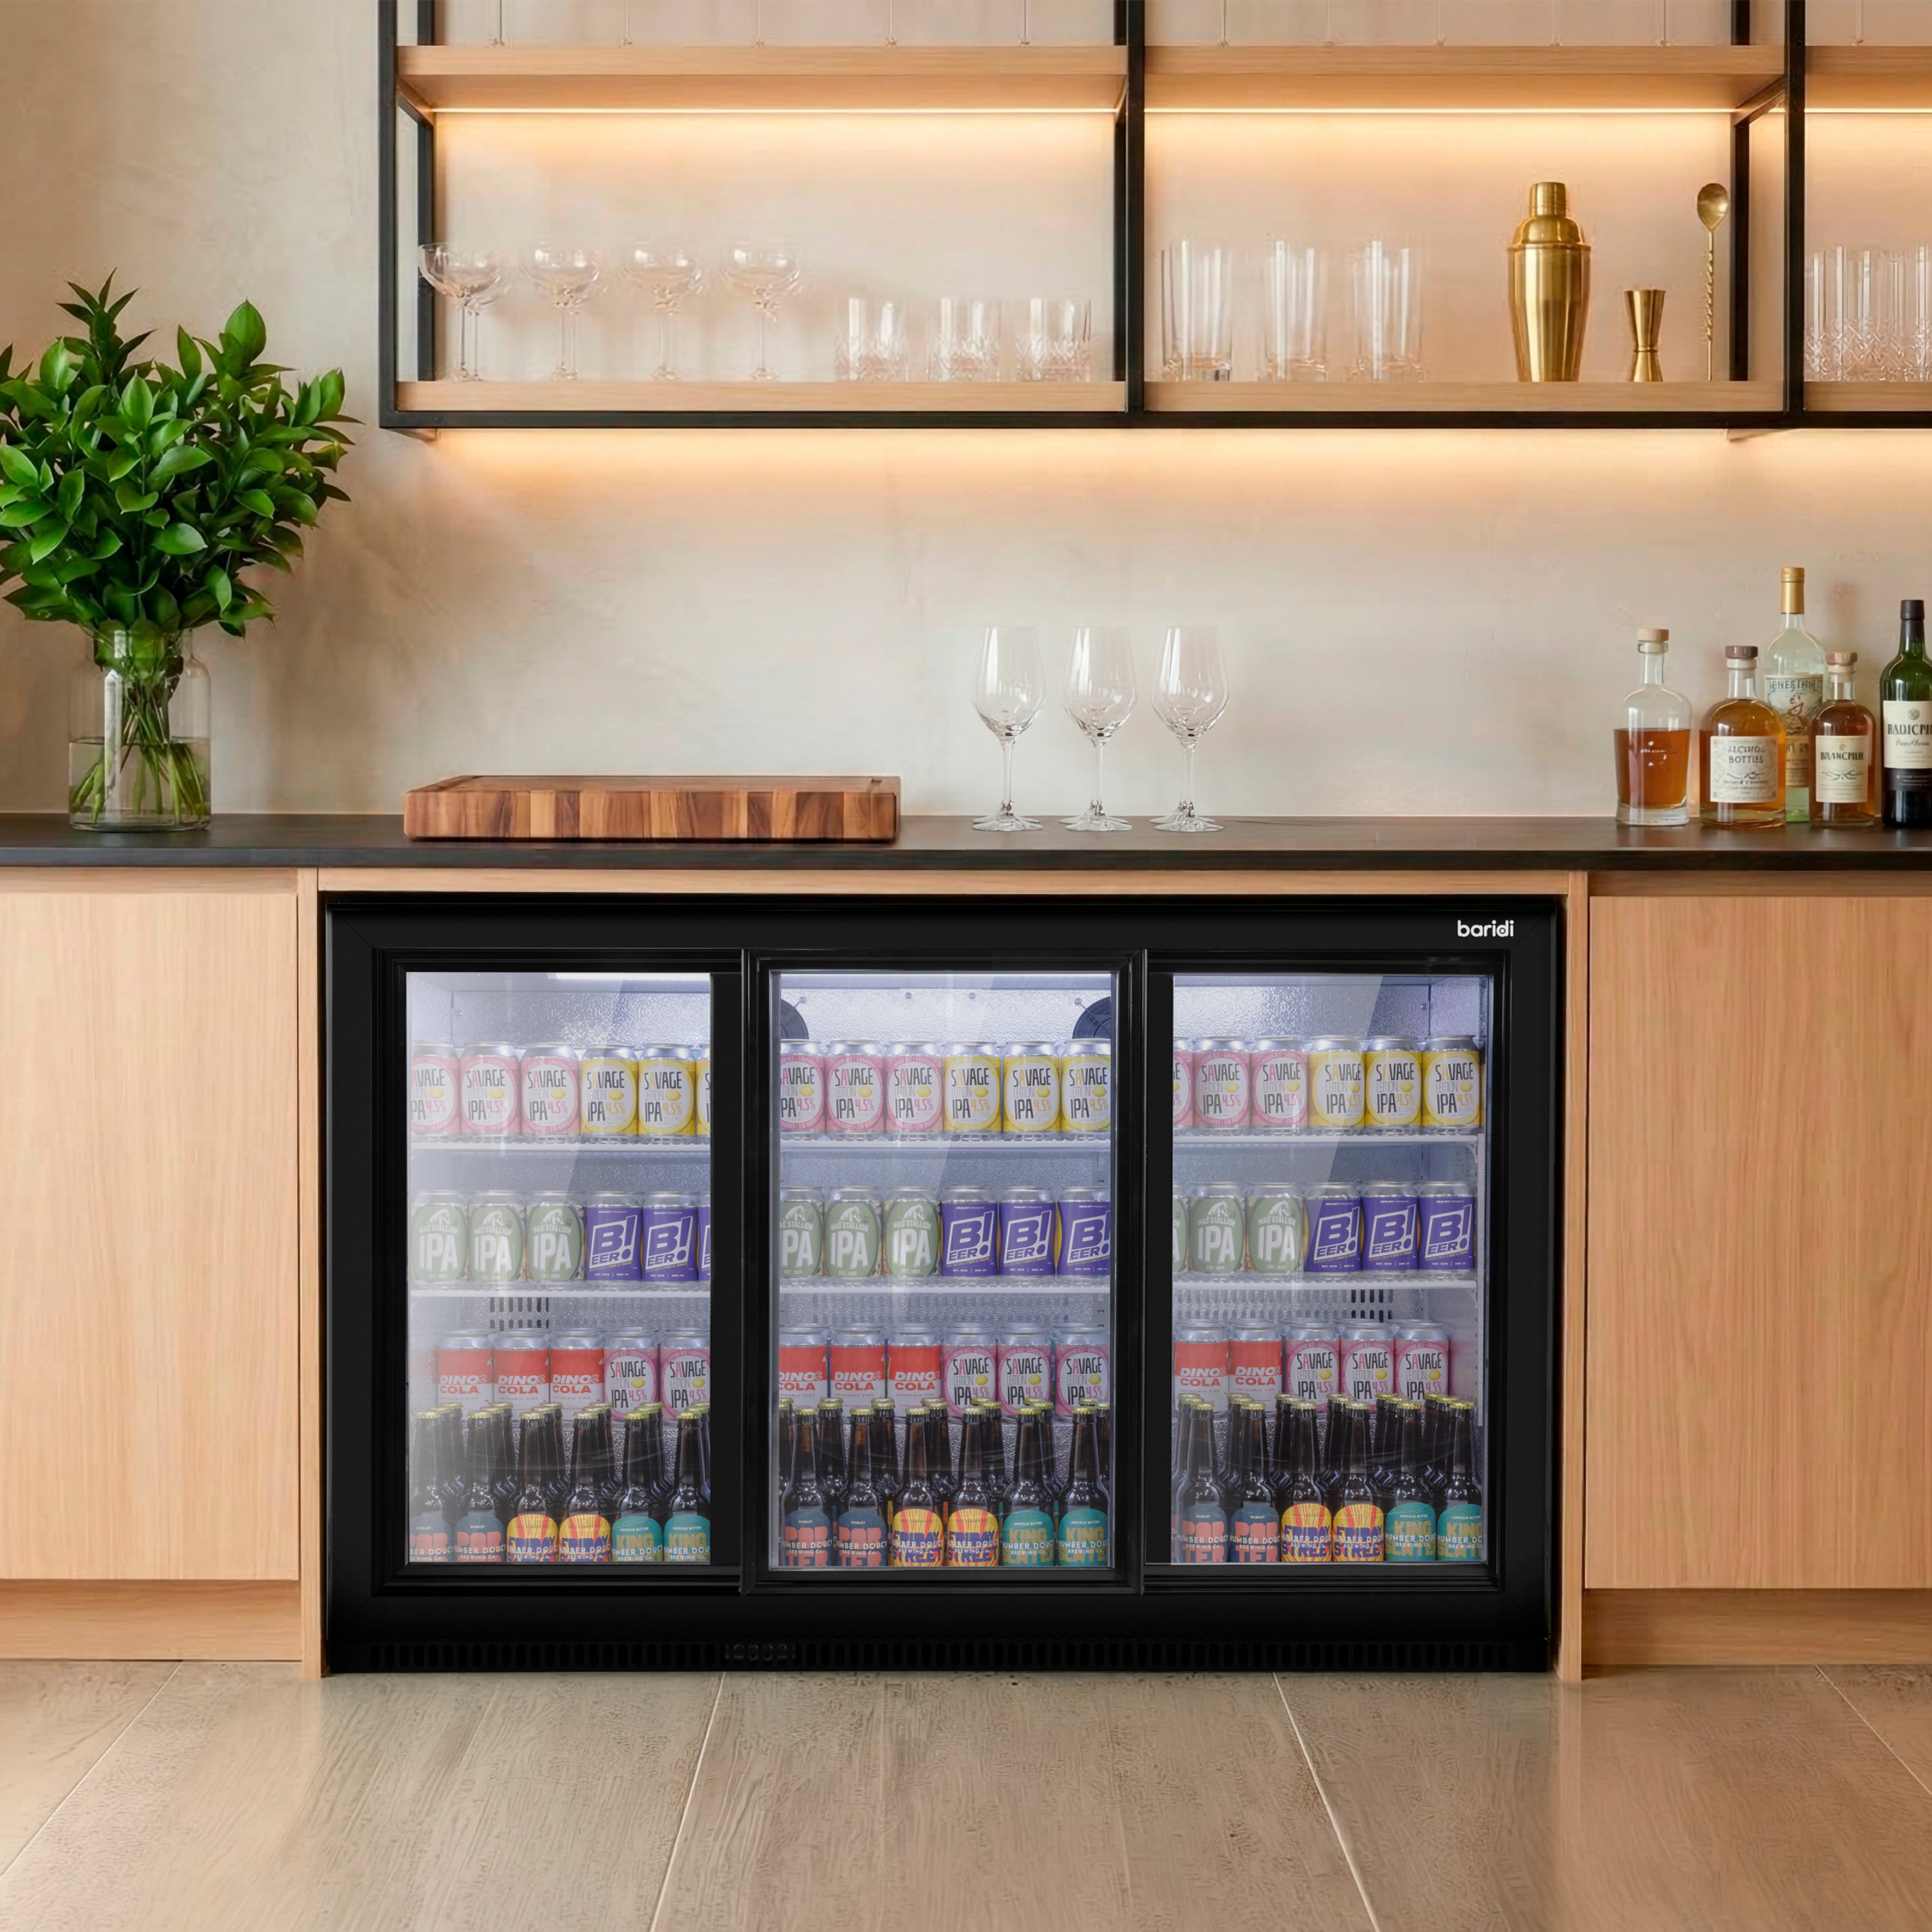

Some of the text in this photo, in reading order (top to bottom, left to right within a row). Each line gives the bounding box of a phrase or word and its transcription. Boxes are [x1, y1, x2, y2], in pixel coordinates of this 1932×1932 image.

[1729, 755, 1764, 763] BOTTLES
[1457, 920, 1514, 937] baridi
[467, 1069, 505, 1088] SAVAGE
[528, 1069, 567, 1089] SAVAGE
[587, 1071, 624, 1090] SAVAGE
[645, 1071, 682, 1090] SAVAGE
[835, 1067, 873, 1086] SAVAGE
[894, 1067, 932, 1086] SAVAGE
[951, 1068, 989, 1087] SAVAGE
[1013, 1067, 1051, 1087] SAVAGE
[1070, 1067, 1108, 1086] SAVAGE
[1202, 1063, 1239, 1082] SAVAGE
[1263, 1063, 1301, 1082] SAVAGE
[1326, 1063, 1361, 1082] SAVAGE
[1376, 1063, 1414, 1081] SAVAGE
[1435, 1063, 1473, 1081] SAVAGE
[587, 1090, 606, 1100] LEMON
[645, 1090, 664, 1101] LEMON
[952, 1086, 972, 1098] LEMON
[1070, 1086, 1091, 1097] LEMON
[1376, 1082, 1398, 1092] LEMON
[468, 1100, 507, 1121] IPA 4.5%
[529, 1100, 548, 1121] IPA
[588, 1102, 625, 1122] IPA 4.5%
[645, 1102, 683, 1122] IPA 4.5%
[836, 1098, 874, 1119] IPA 4.5%
[895, 1098, 933, 1118] IPA 4.5%
[952, 1098, 990, 1119] IPA 4.5%
[1014, 1099, 1052, 1120] IPA 4.5%
[1070, 1098, 1109, 1119] IPA 4.5%
[1203, 1094, 1241, 1114] IPA 4.5%
[1265, 1093, 1302, 1114] IPA 4.5%
[1326, 1093, 1346, 1114] IPA
[1377, 1093, 1415, 1114] IPA 4.5%
[1437, 1093, 1474, 1114] IPA 4.5%
[545, 1225, 572, 1235] STALLION
[830, 1222, 869, 1232] MAD STALLION
[905, 1220, 931, 1230] STALLION
[1209, 1217, 1236, 1227] STALLION
[1270, 1217, 1296, 1226] STALLION
[473, 1226, 512, 1236] MAD STALLION
[419, 1233, 458, 1272] IPA
[533, 1233, 571, 1272] IPA
[830, 1230, 868, 1269] IPA
[893, 1229, 931, 1267] IPA
[1198, 1225, 1235, 1263] IPA
[1257, 1225, 1295, 1263] IPA
[474, 1235, 512, 1273] IPA
[610, 1361, 646, 1378] SAVAGE
[670, 1360, 706, 1378] SAVAGE
[953, 1357, 989, 1375] SAVAGE
[1006, 1357, 1042, 1374] SAVAGE
[1067, 1356, 1102, 1375] SAVAGE
[1297, 1352, 1332, 1369] SAVAGE
[1353, 1352, 1388, 1369] SAVAGE
[1406, 1352, 1441, 1370] SAVAGE
[440, 1375, 479, 1384] DINO
[498, 1375, 538, 1384] DINO
[552, 1374, 591, 1384] DINO
[834, 1371, 873, 1381] DINO
[894, 1371, 934, 1381] DINO
[1181, 1368, 1219, 1376] DINO
[1235, 1367, 1274, 1376] DINO
[1297, 1369, 1317, 1380] LEMON
[1353, 1370, 1373, 1380] LEMON
[440, 1386, 480, 1394] COLA
[498, 1386, 539, 1394] COLA
[552, 1385, 592, 1394] COLA
[611, 1378, 629, 1388] LEMON
[670, 1378, 690, 1388] LEMON
[834, 1382, 875, 1391] COLA
[894, 1382, 936, 1391] COLA
[1180, 1378, 1220, 1386] COLA
[1235, 1377, 1275, 1385] COLA
[1298, 1381, 1316, 1399] IPA
[1353, 1381, 1389, 1399] IPA 4.5%
[611, 1389, 647, 1408] IPA 4.5%
[671, 1389, 707, 1408] IPA 4.5%
[954, 1386, 972, 1405] IPA
[1007, 1386, 1025, 1405] IPA
[1407, 1381, 1424, 1400] IPA
[1009, 1527, 1048, 1544] KING
[1067, 1527, 1104, 1543] KING
[1394, 1520, 1431, 1538] KING
[616, 1533, 654, 1550] KING
[669, 1533, 707, 1550] KING
[894, 1531, 940, 1546] FRIDAY
[949, 1530, 995, 1548] FRIDAY
[893, 1546, 942, 1563] STREET
[948, 1546, 998, 1563] STREET
